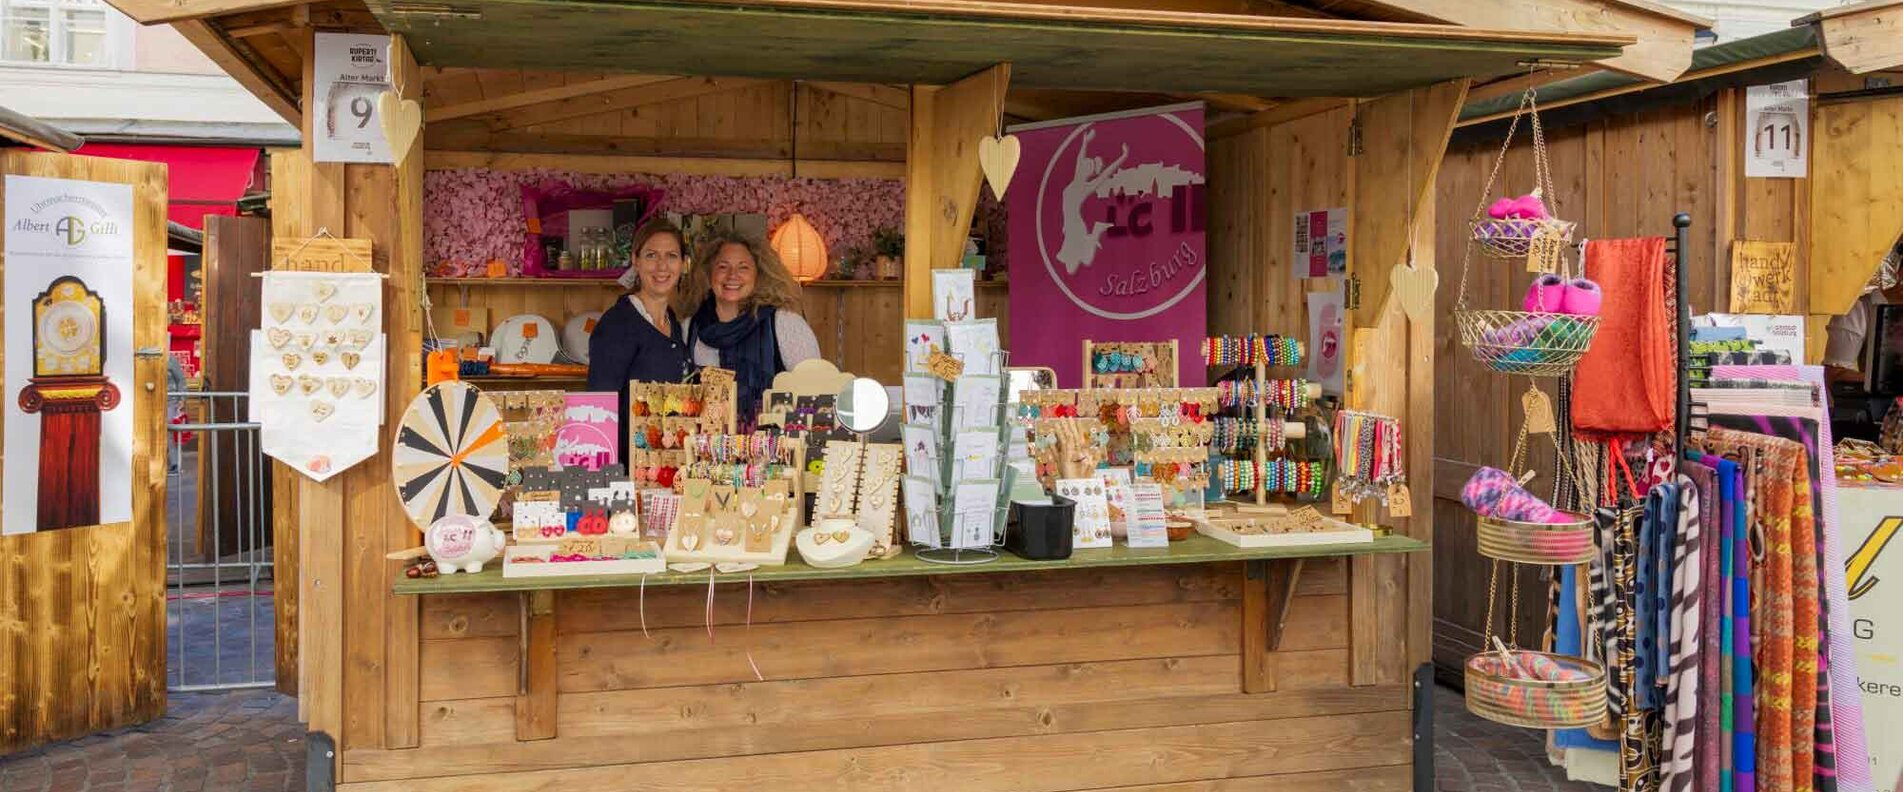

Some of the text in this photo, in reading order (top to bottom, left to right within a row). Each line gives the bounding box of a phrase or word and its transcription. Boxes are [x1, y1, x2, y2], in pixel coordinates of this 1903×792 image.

[340, 73, 359, 81] Alter
[350, 96, 373, 129] 9
[1764, 123, 1790, 150] 11
[13, 218, 50, 232] Albert
[90, 221, 119, 235] Gilli
[285, 252, 345, 272] hand
[1099, 241, 1198, 296] Salzburg
